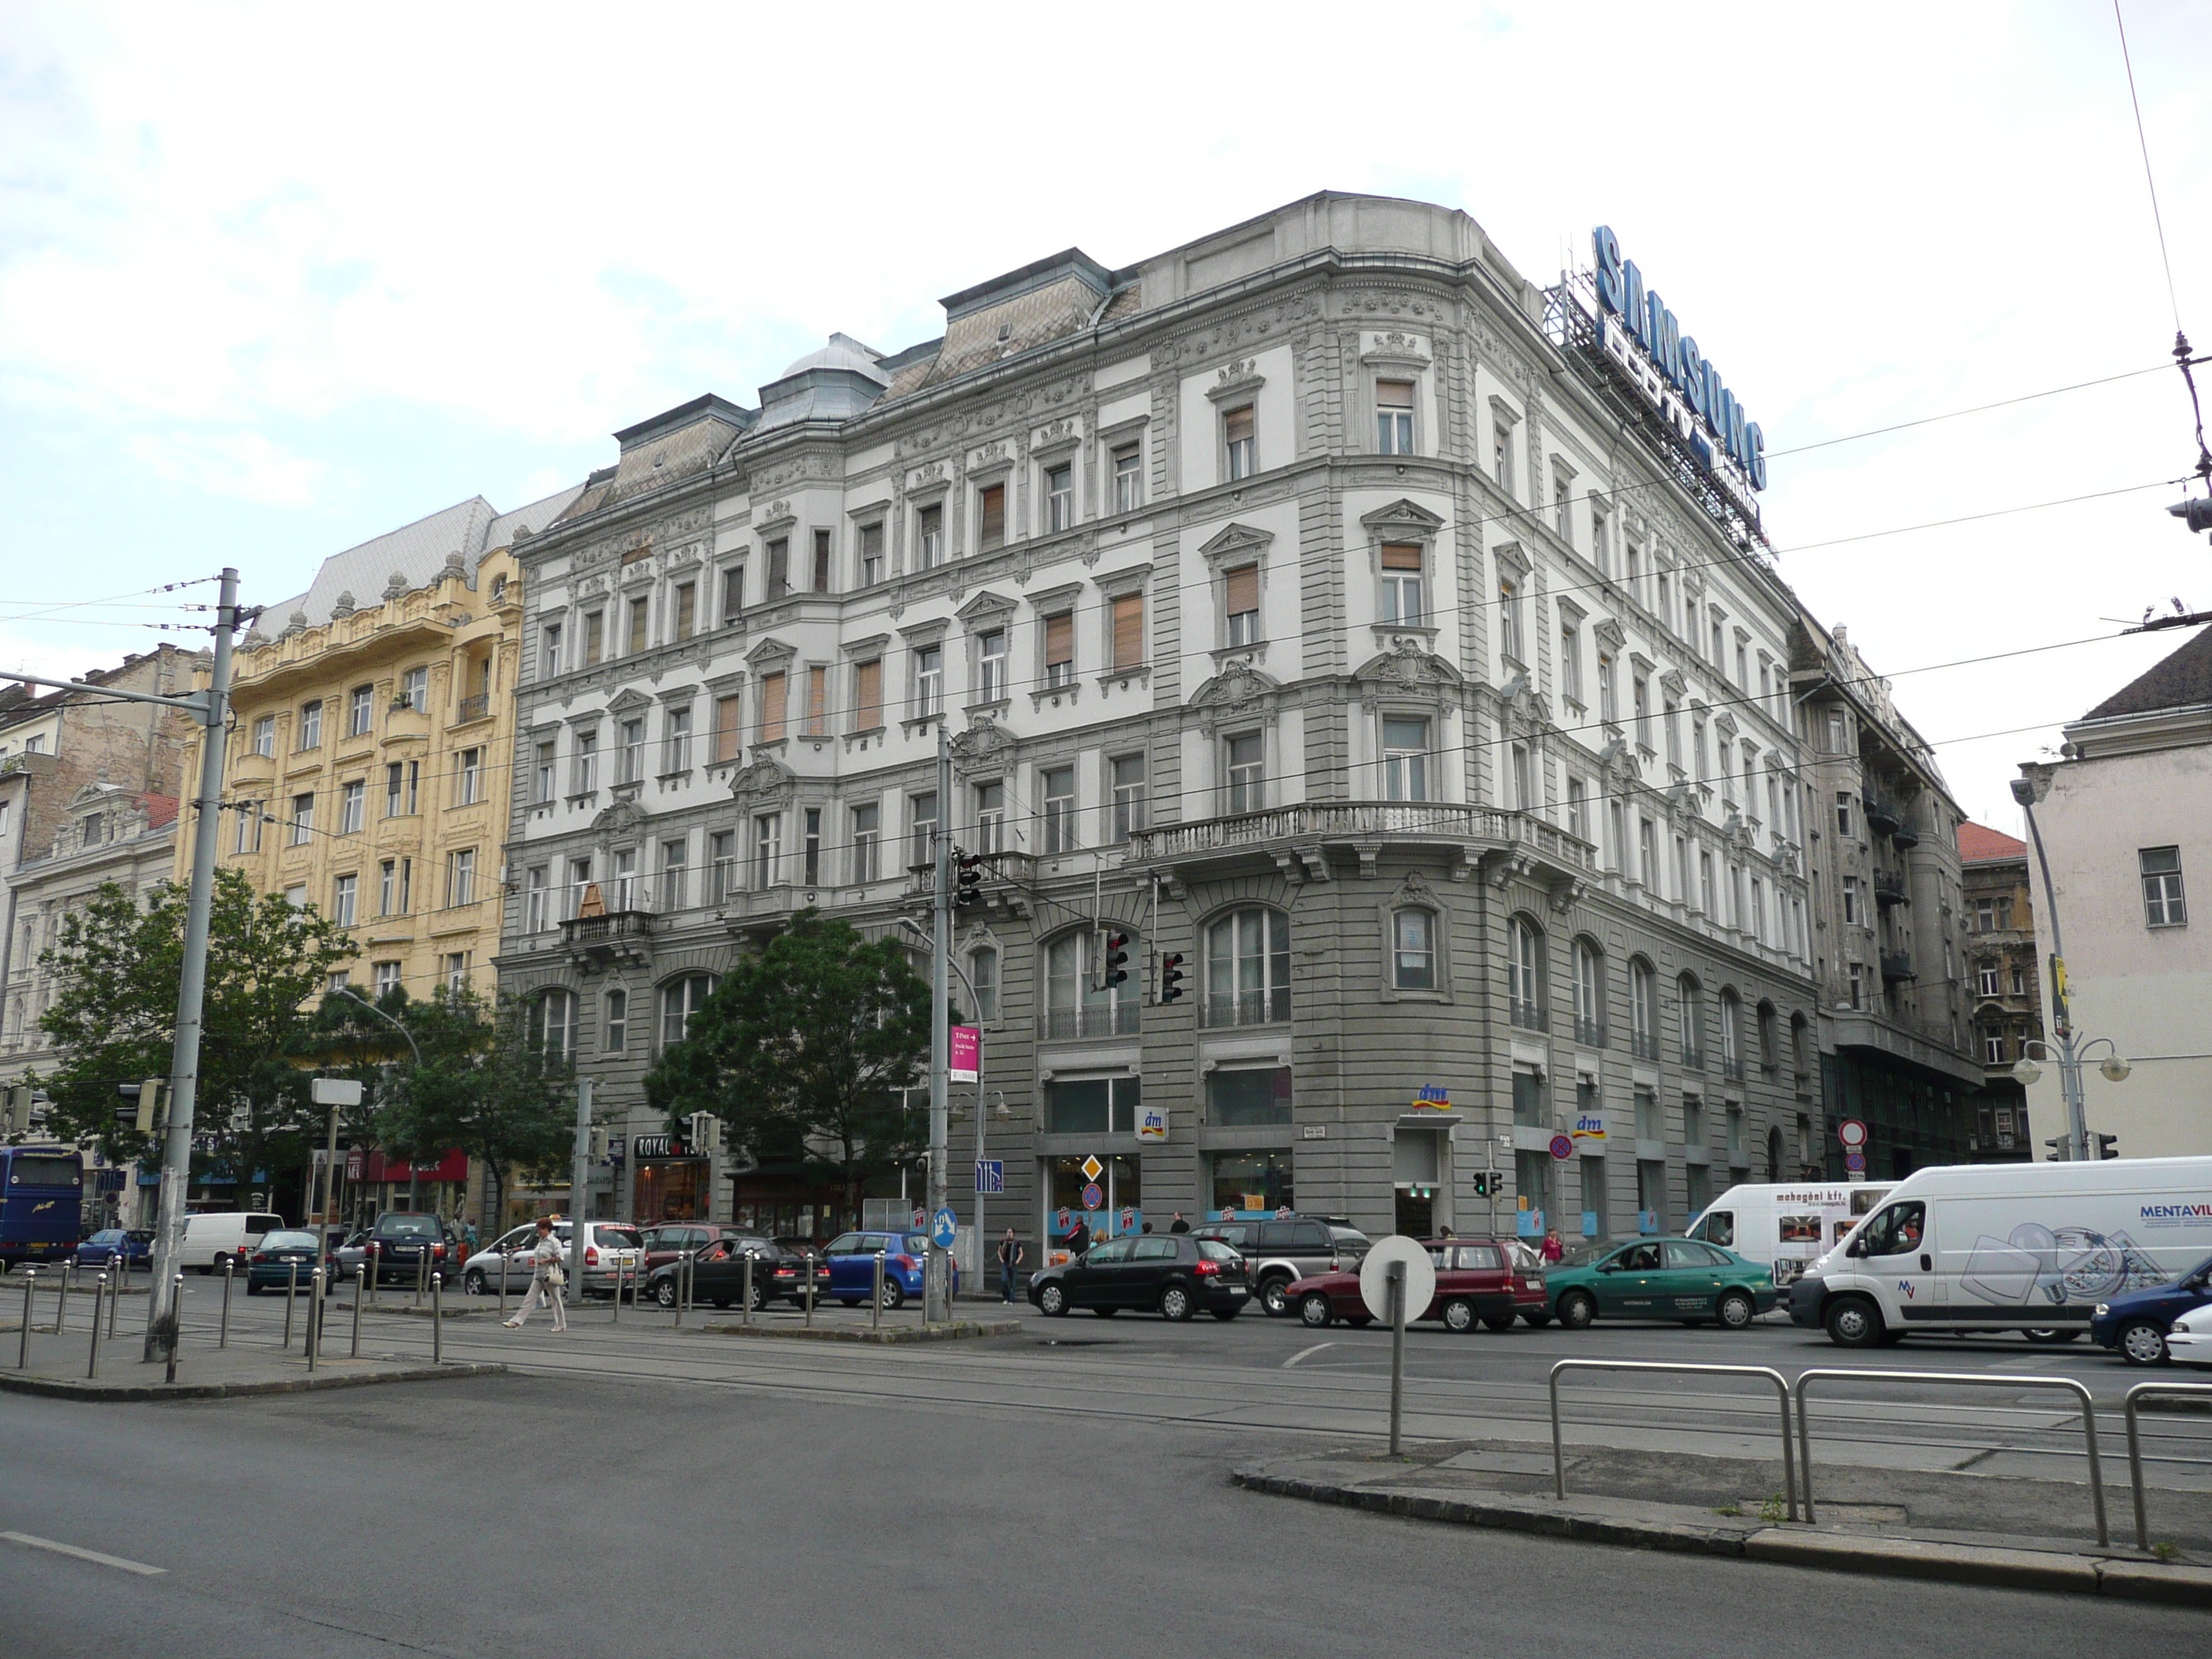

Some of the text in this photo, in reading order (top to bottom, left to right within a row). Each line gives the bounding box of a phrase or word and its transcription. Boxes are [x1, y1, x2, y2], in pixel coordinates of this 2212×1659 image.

[1592, 225, 1767, 491] SAMSUNG
[1419, 1082, 1447, 1100] dm
[1145, 1111, 1161, 1127] dm
[1577, 1115, 1601, 1130] dm
[639, 1138, 670, 1156] ROYAL
[1776, 1190, 1846, 1203] mahagóni kft.
